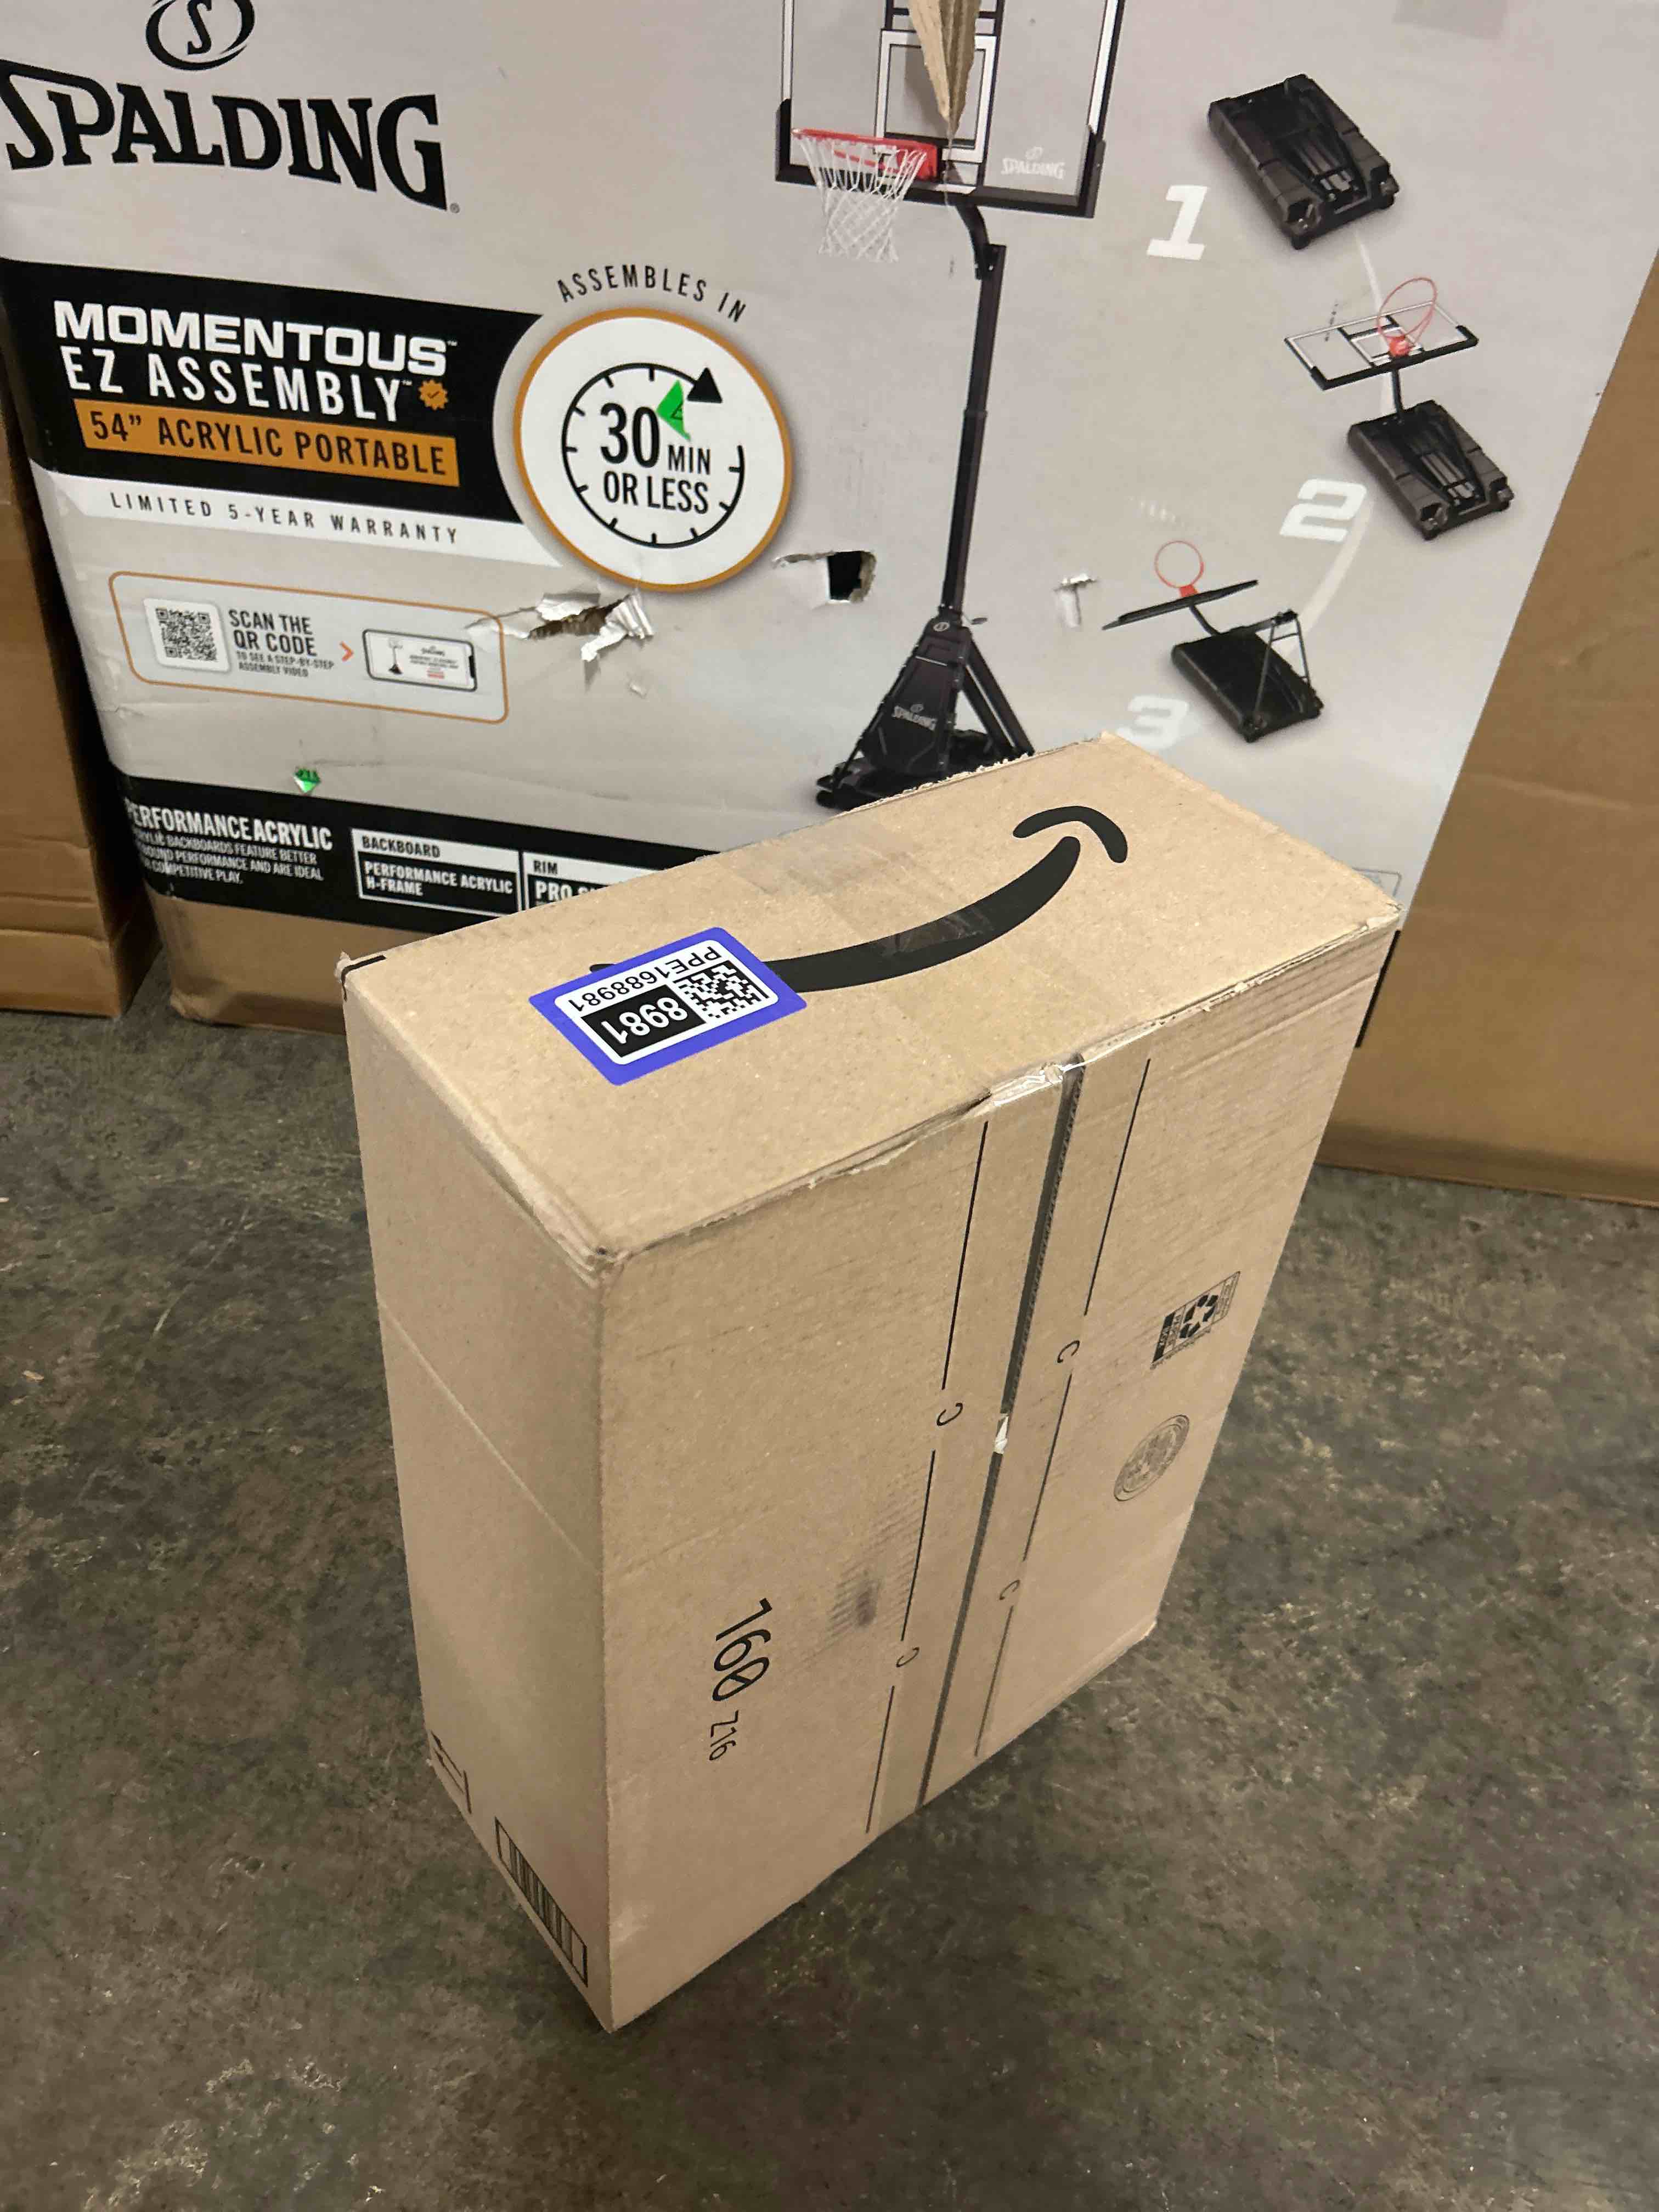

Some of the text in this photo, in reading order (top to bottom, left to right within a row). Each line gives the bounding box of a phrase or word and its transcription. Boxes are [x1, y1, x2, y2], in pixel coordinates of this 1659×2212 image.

[0, 59, 447, 211] SPALDING
[1147, 185, 1207, 260] 1
[557, 264, 747, 323] ASSEMBLES IN
[60, 345, 123, 394] EZ
[158, 417, 284, 458] ACRYLIC
[295, 431, 447, 475] PORTABLE
[600, 402, 711, 475] 30 MIN
[603, 470, 709, 515] OR LESS
[1279, 479, 1367, 543] 2
[111, 492, 459, 545] LIMITED 5-YEAR WARRANTY
[228, 609, 313, 635] SCAN THE
[233, 630, 317, 657] QR CODE
[1115, 695, 1189, 750] 3
[235, 843, 278, 860] FEATURE
[279, 849, 317, 865] BETTER
[253, 819, 333, 850] ACRYLIC
[362, 835, 441, 858] BACKBOARD
[174, 850, 247, 871] PERFORMANCE
[250, 859, 272, 874] AND
[273, 862, 294, 877] ARE
[294, 865, 324, 881] IDEAL
[363, 860, 514, 894] PERFORMANCE ACRYLIC
[366, 875, 424, 896] H-FRAME
[533, 859, 558, 875] RIM
[535, 879, 573, 901] PRO
[568, 946, 722, 1012] PPE1688981
[600, 997, 689, 1045] 8981
[712, 1598, 772, 1701] 160
